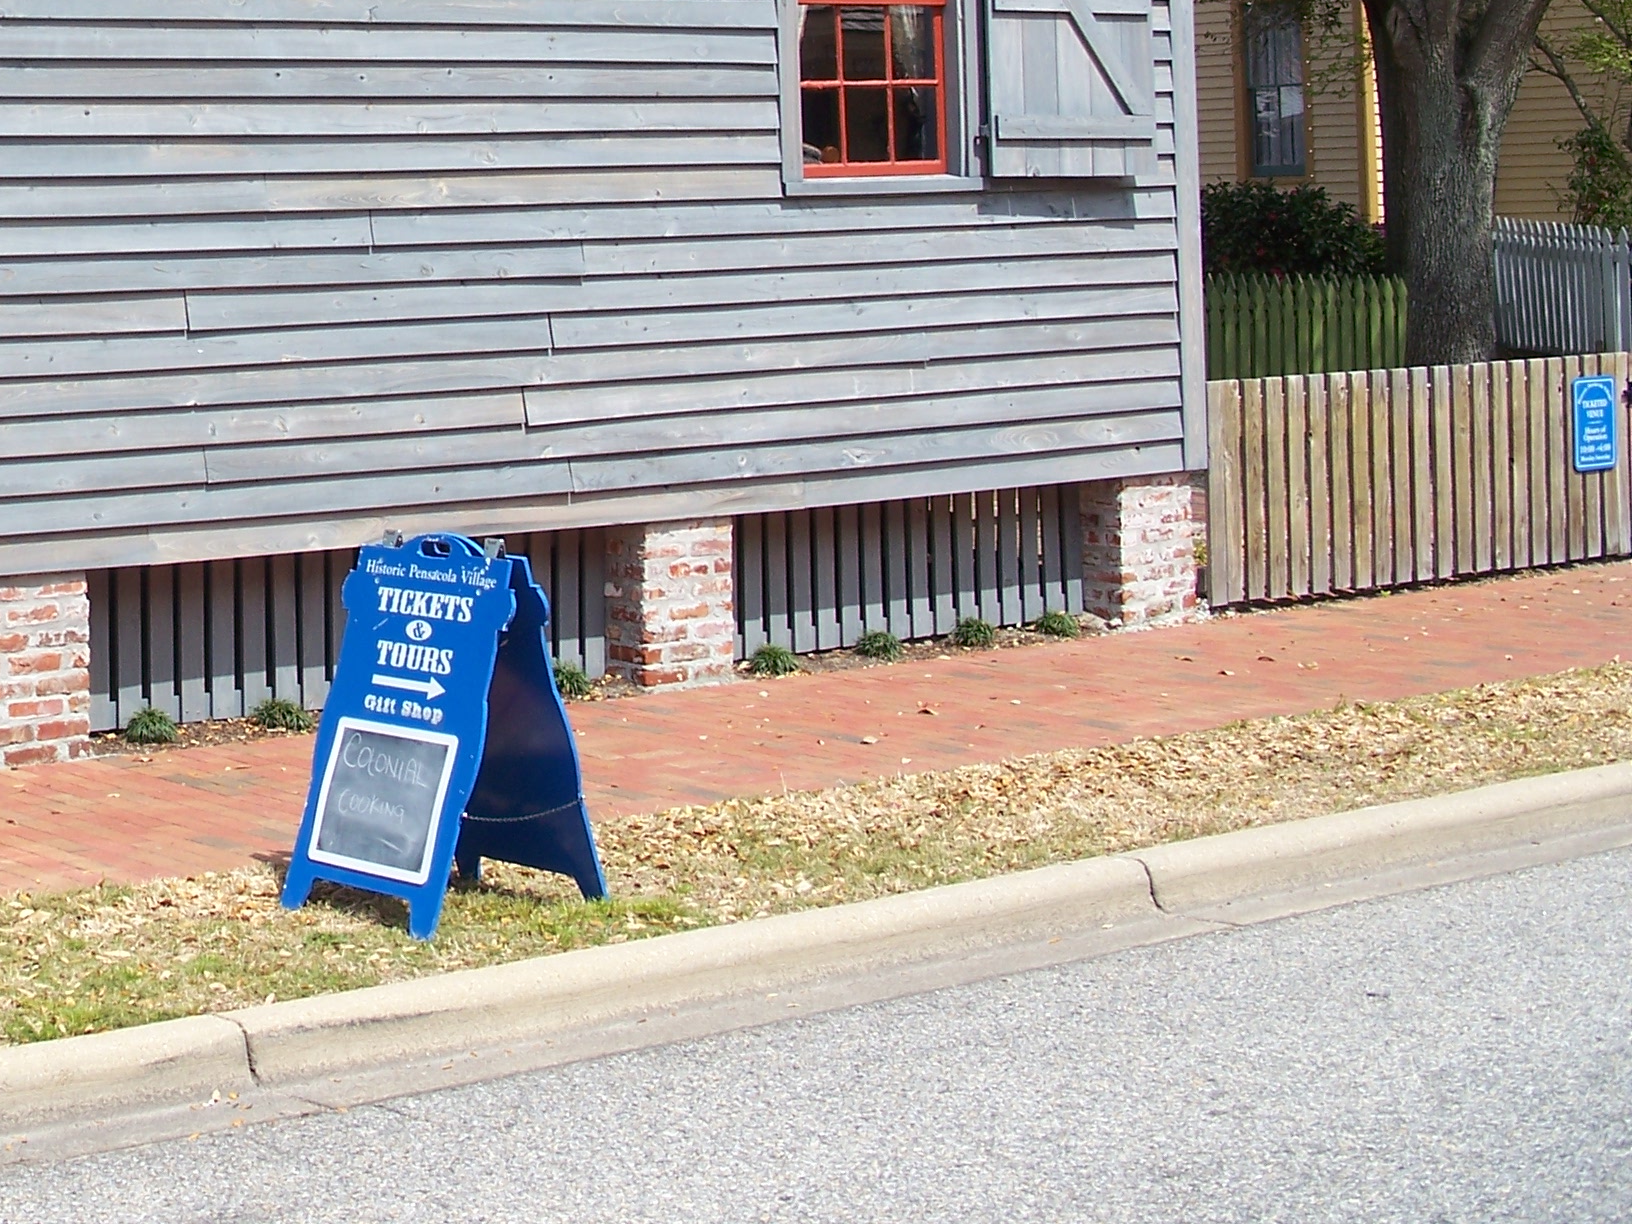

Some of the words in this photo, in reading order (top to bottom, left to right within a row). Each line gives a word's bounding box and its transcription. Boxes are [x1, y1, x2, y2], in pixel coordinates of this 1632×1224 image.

[366, 559, 406, 577] Historic
[409, 564, 457, 584] Pensacola
[461, 569, 497, 590] Village
[377, 586, 474, 623] TICKETS
[412, 622, 428, 639] &
[377, 639, 454, 675] TOURS
[364, 694, 397, 712] Gift
[401, 700, 444, 725] Shop
[338, 788, 405, 825] COOKING
